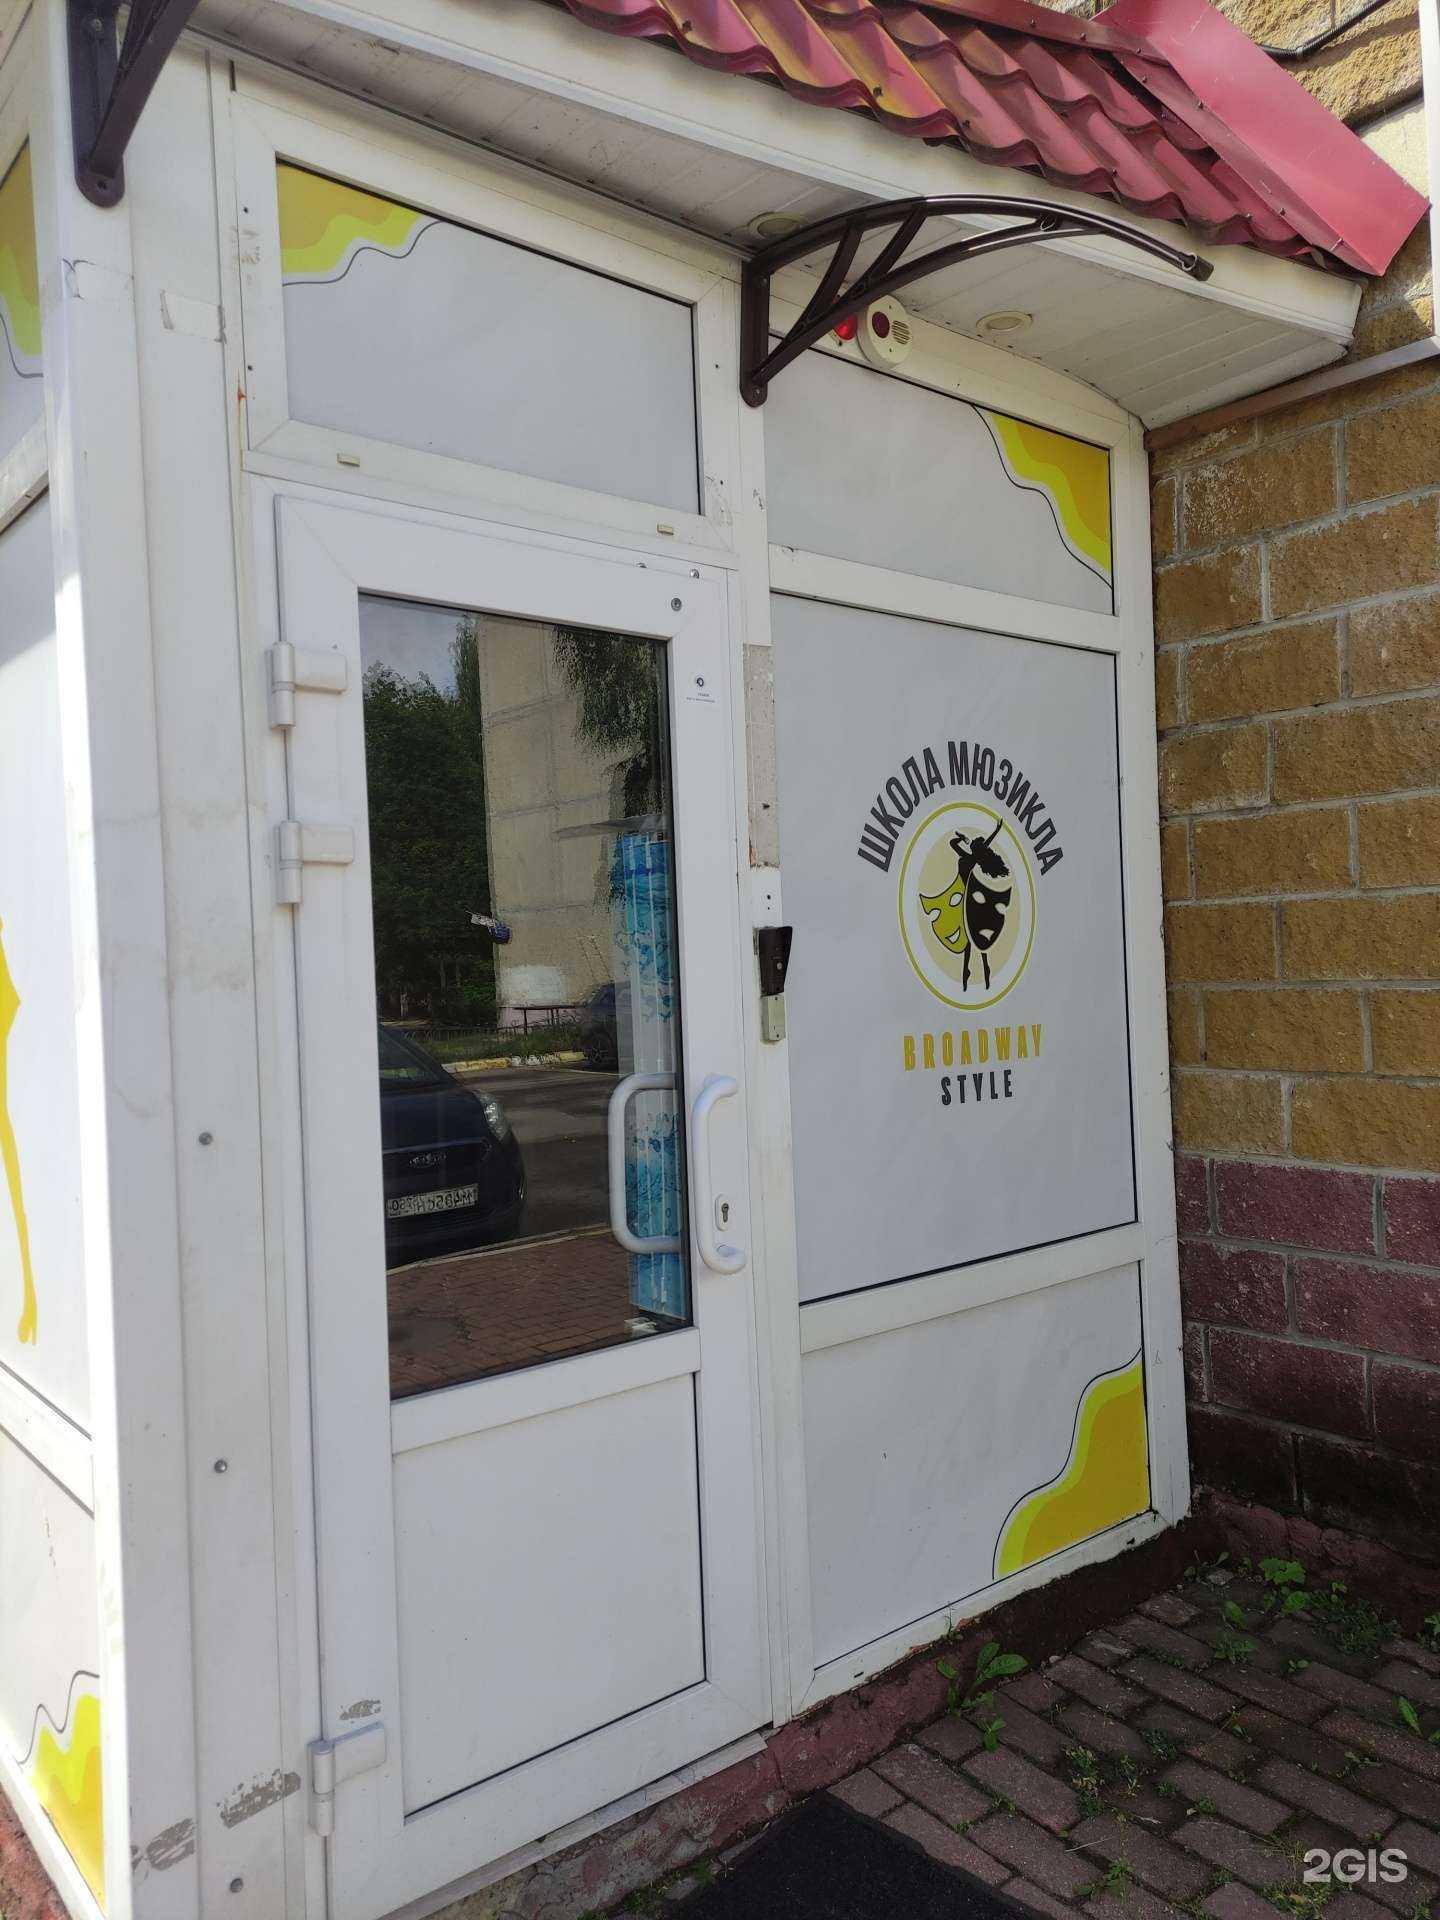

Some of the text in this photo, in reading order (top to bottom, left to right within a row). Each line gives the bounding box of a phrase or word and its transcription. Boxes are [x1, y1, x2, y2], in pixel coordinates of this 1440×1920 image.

[857, 740, 1065, 877] ШКОЛА МЮЗИКЛА
[904, 1023, 1043, 1072] BROADWAY
[940, 1068, 1014, 1107] STYLE
